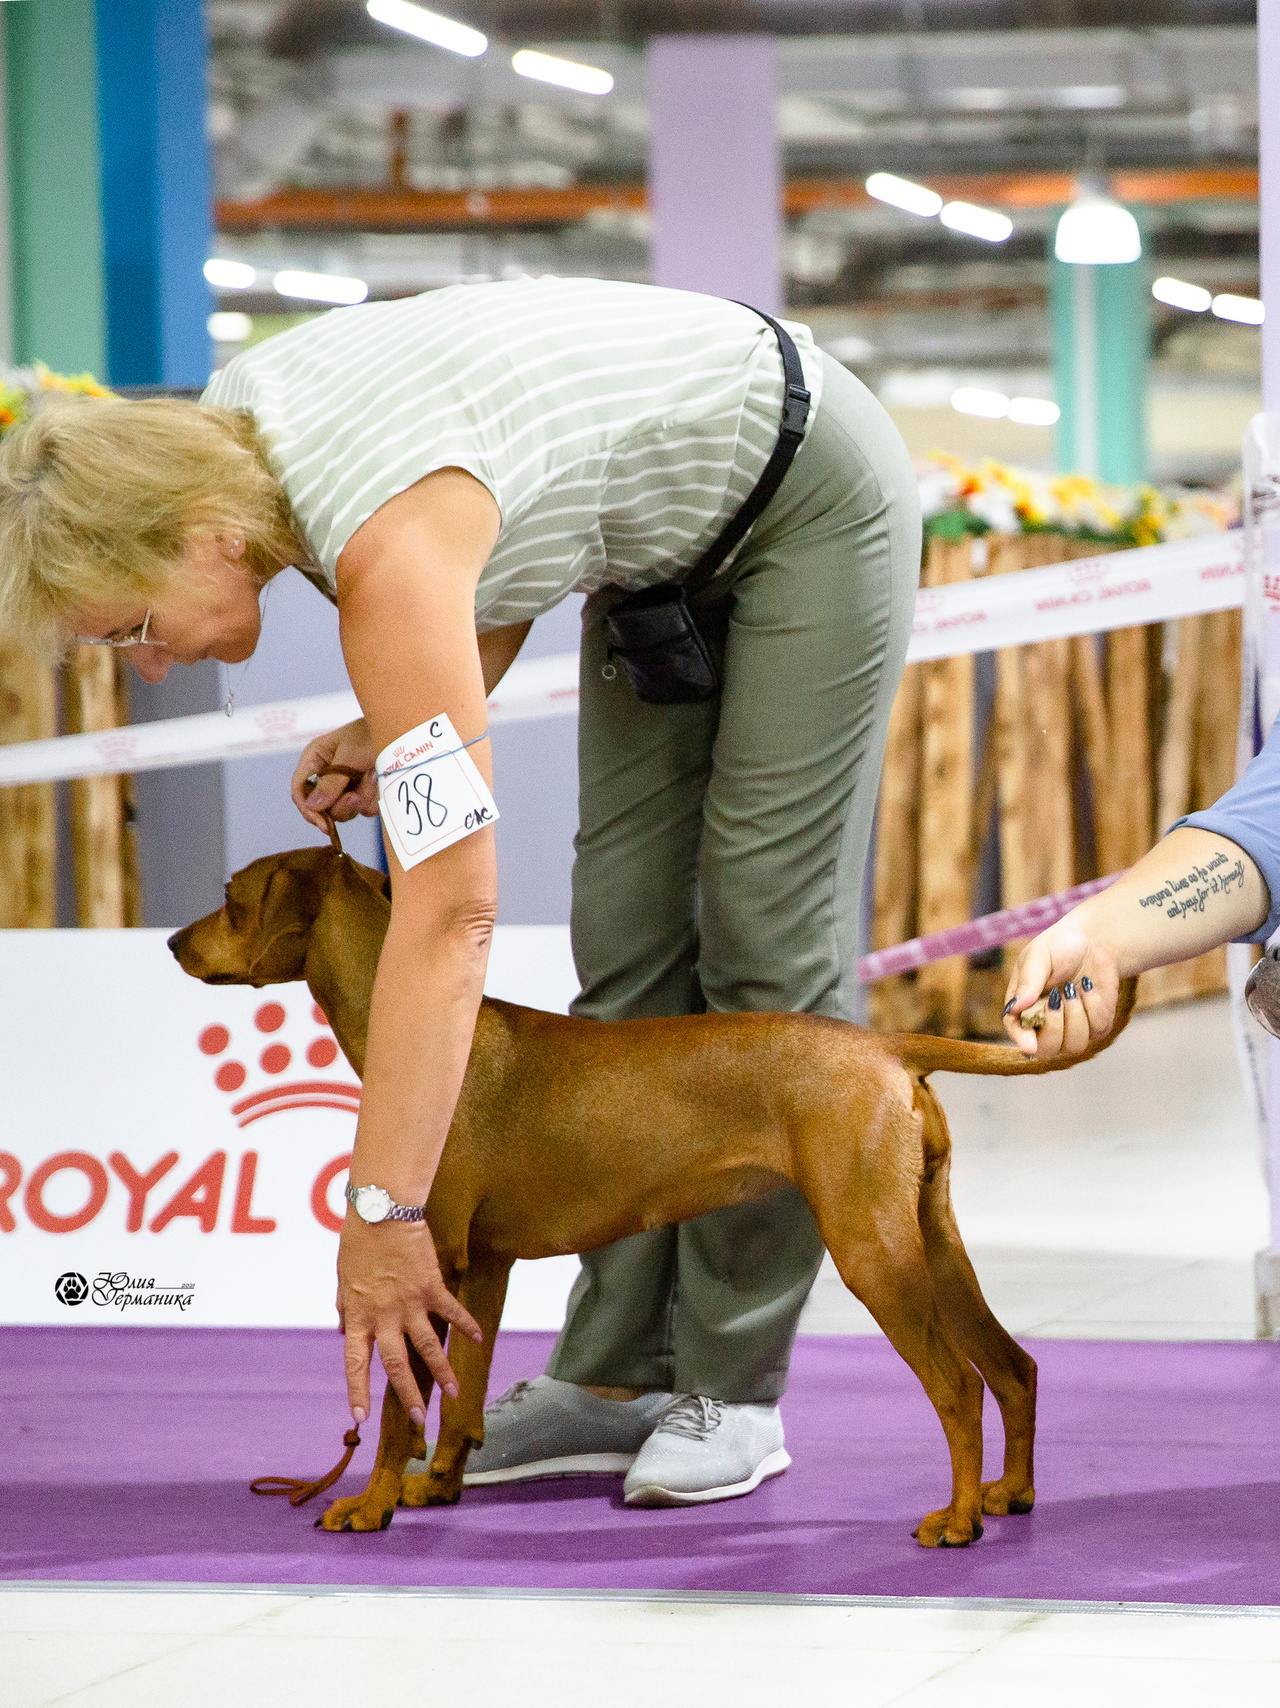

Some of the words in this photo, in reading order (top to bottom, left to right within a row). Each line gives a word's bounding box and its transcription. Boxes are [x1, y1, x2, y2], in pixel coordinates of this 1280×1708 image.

[430, 721, 443, 738] C
[403, 741, 434, 762] CANIN
[398, 773, 448, 836] 38
